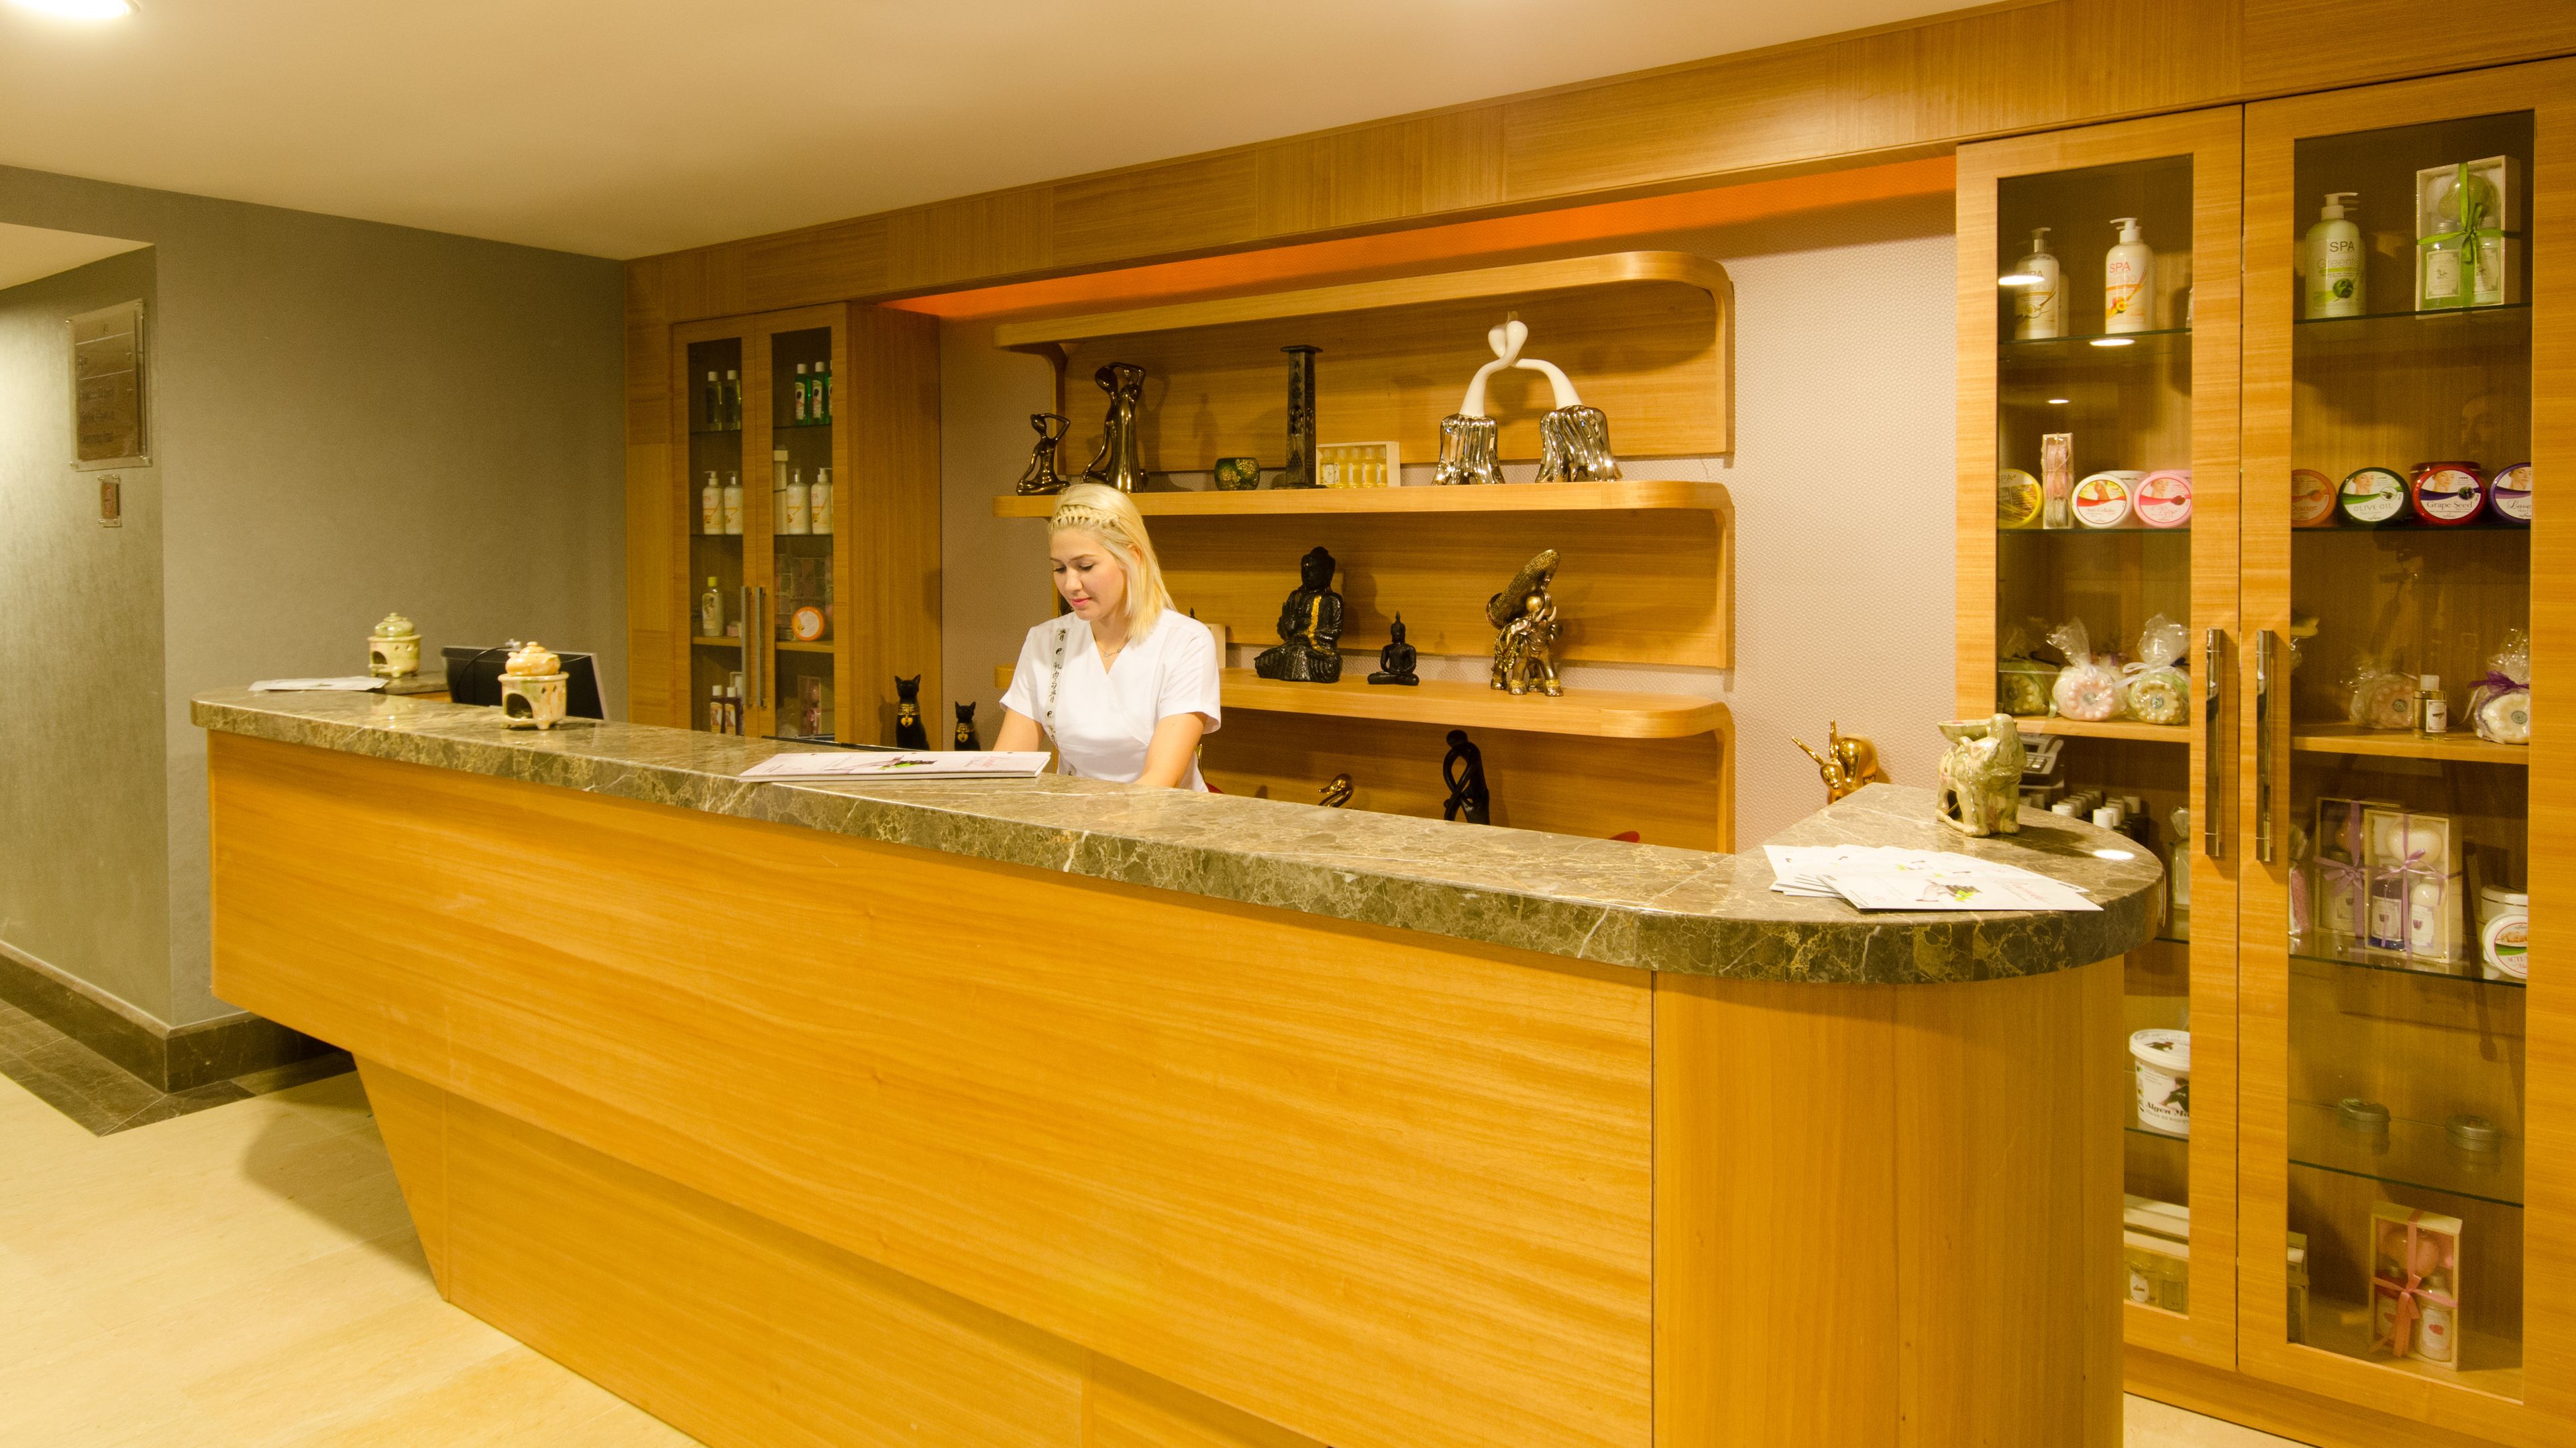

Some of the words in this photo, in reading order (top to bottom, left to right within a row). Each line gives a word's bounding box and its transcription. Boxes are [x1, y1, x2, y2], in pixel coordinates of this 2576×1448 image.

[2329, 241, 2355, 252] SPA
[2110, 262, 2131, 274] SPA
[2426, 501, 2451, 510] Grape
[2454, 501, 2473, 509] Seed
